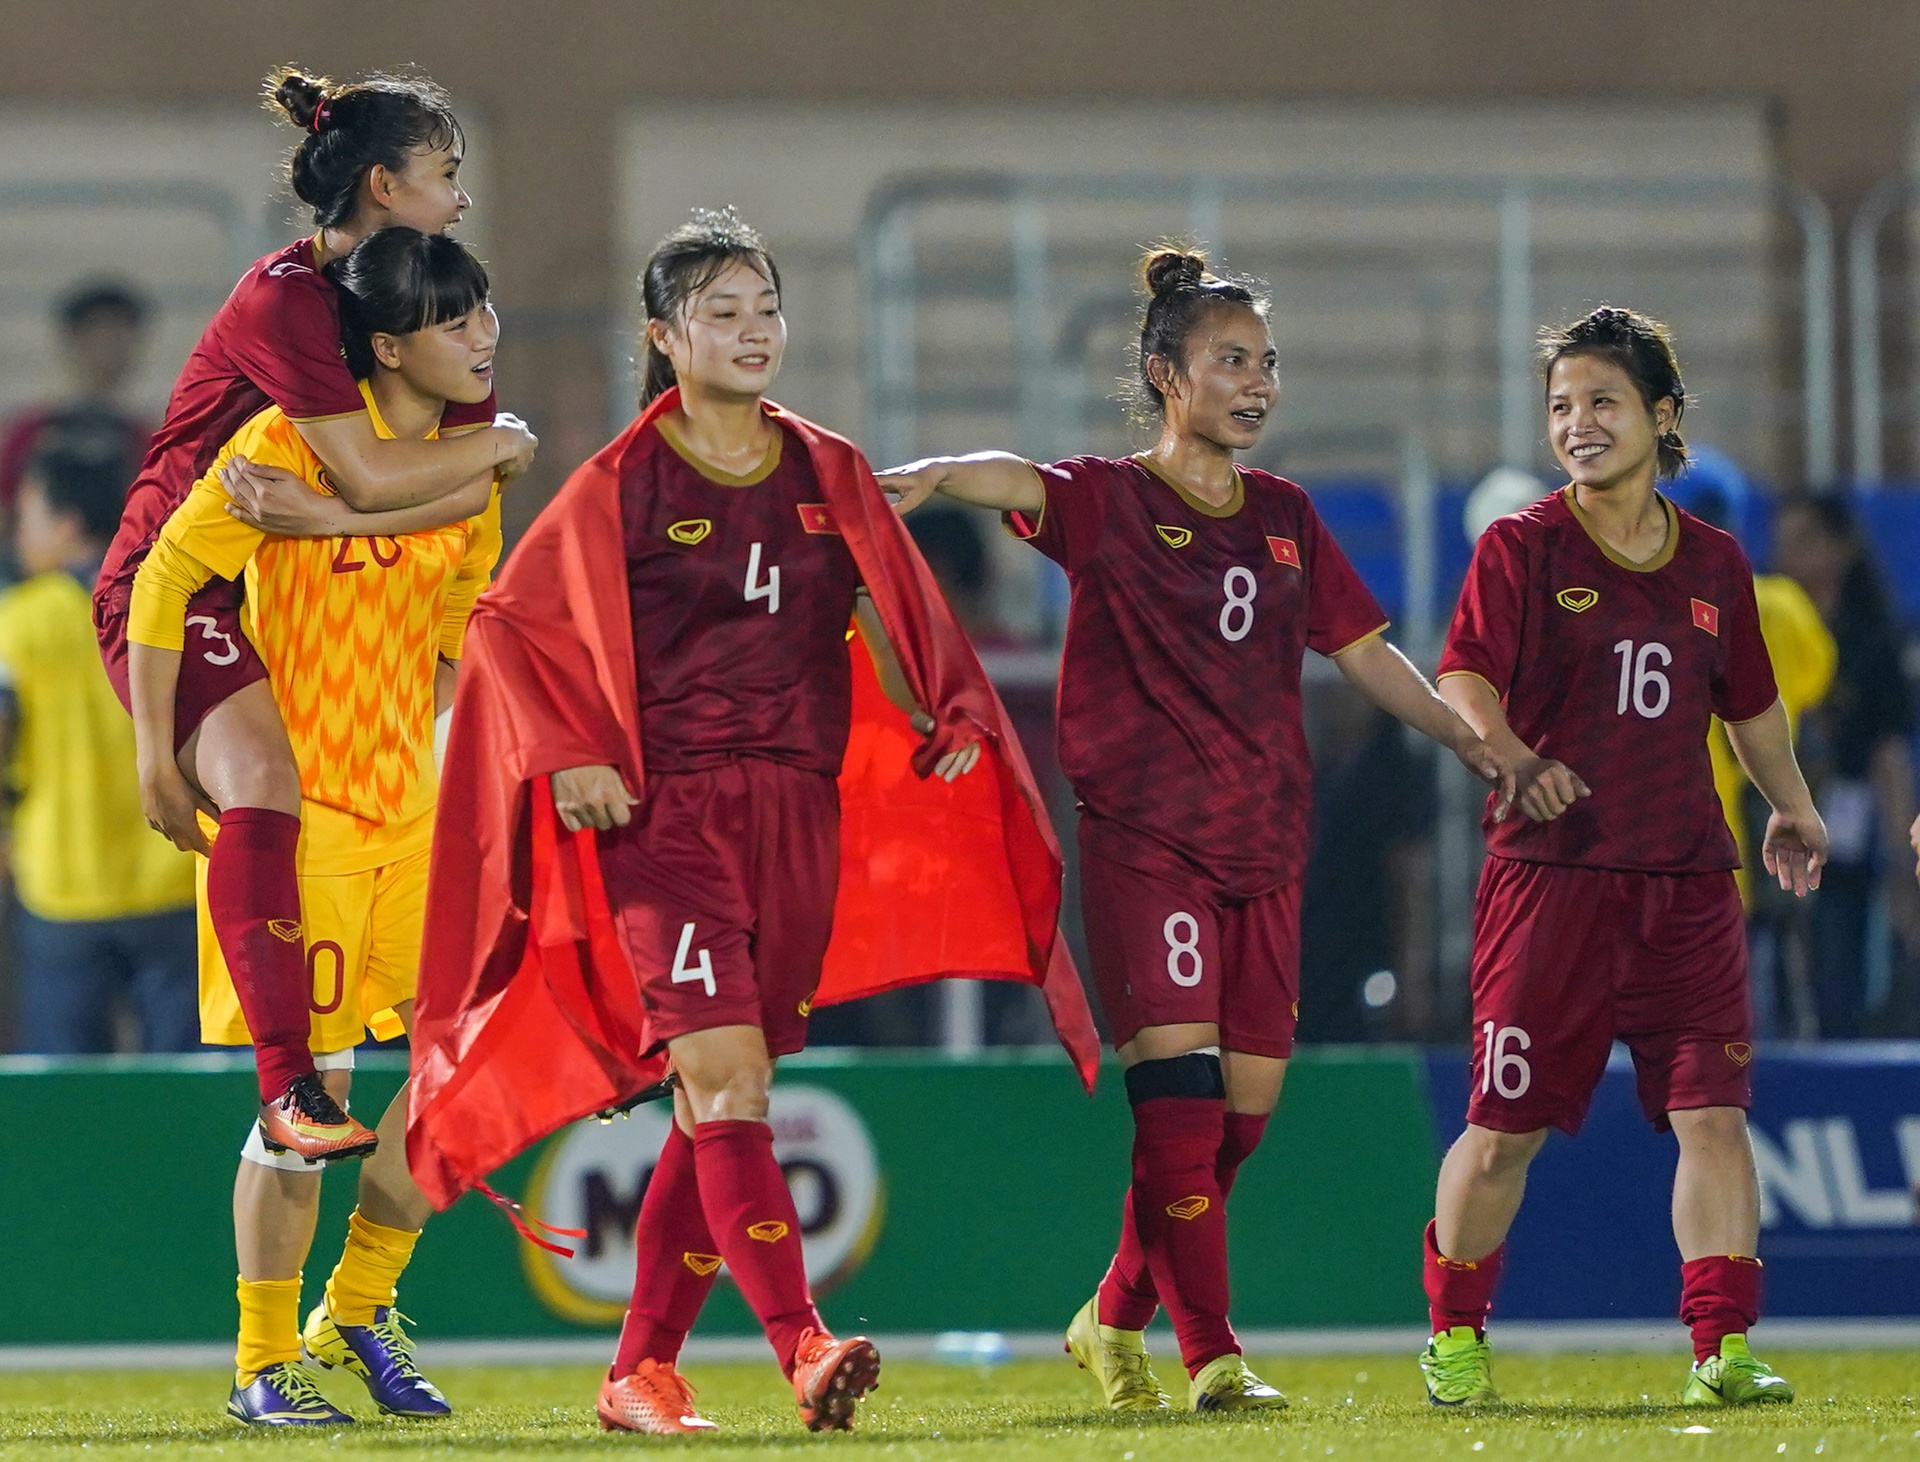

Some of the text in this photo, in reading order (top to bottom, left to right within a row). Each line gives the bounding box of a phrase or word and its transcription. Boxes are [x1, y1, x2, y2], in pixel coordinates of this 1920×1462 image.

[743, 542, 780, 614] 4
[1219, 566, 1257, 642] 8
[185, 615, 240, 666] 3
[1614, 639, 1672, 718] 16
[307, 939, 344, 1014] 0
[671, 922, 716, 997] 4
[1163, 911, 1203, 987] 8
[1482, 1020, 1531, 1099] 16
[579, 1156, 842, 1259] MO
[1748, 1117, 1920, 1228] NL
